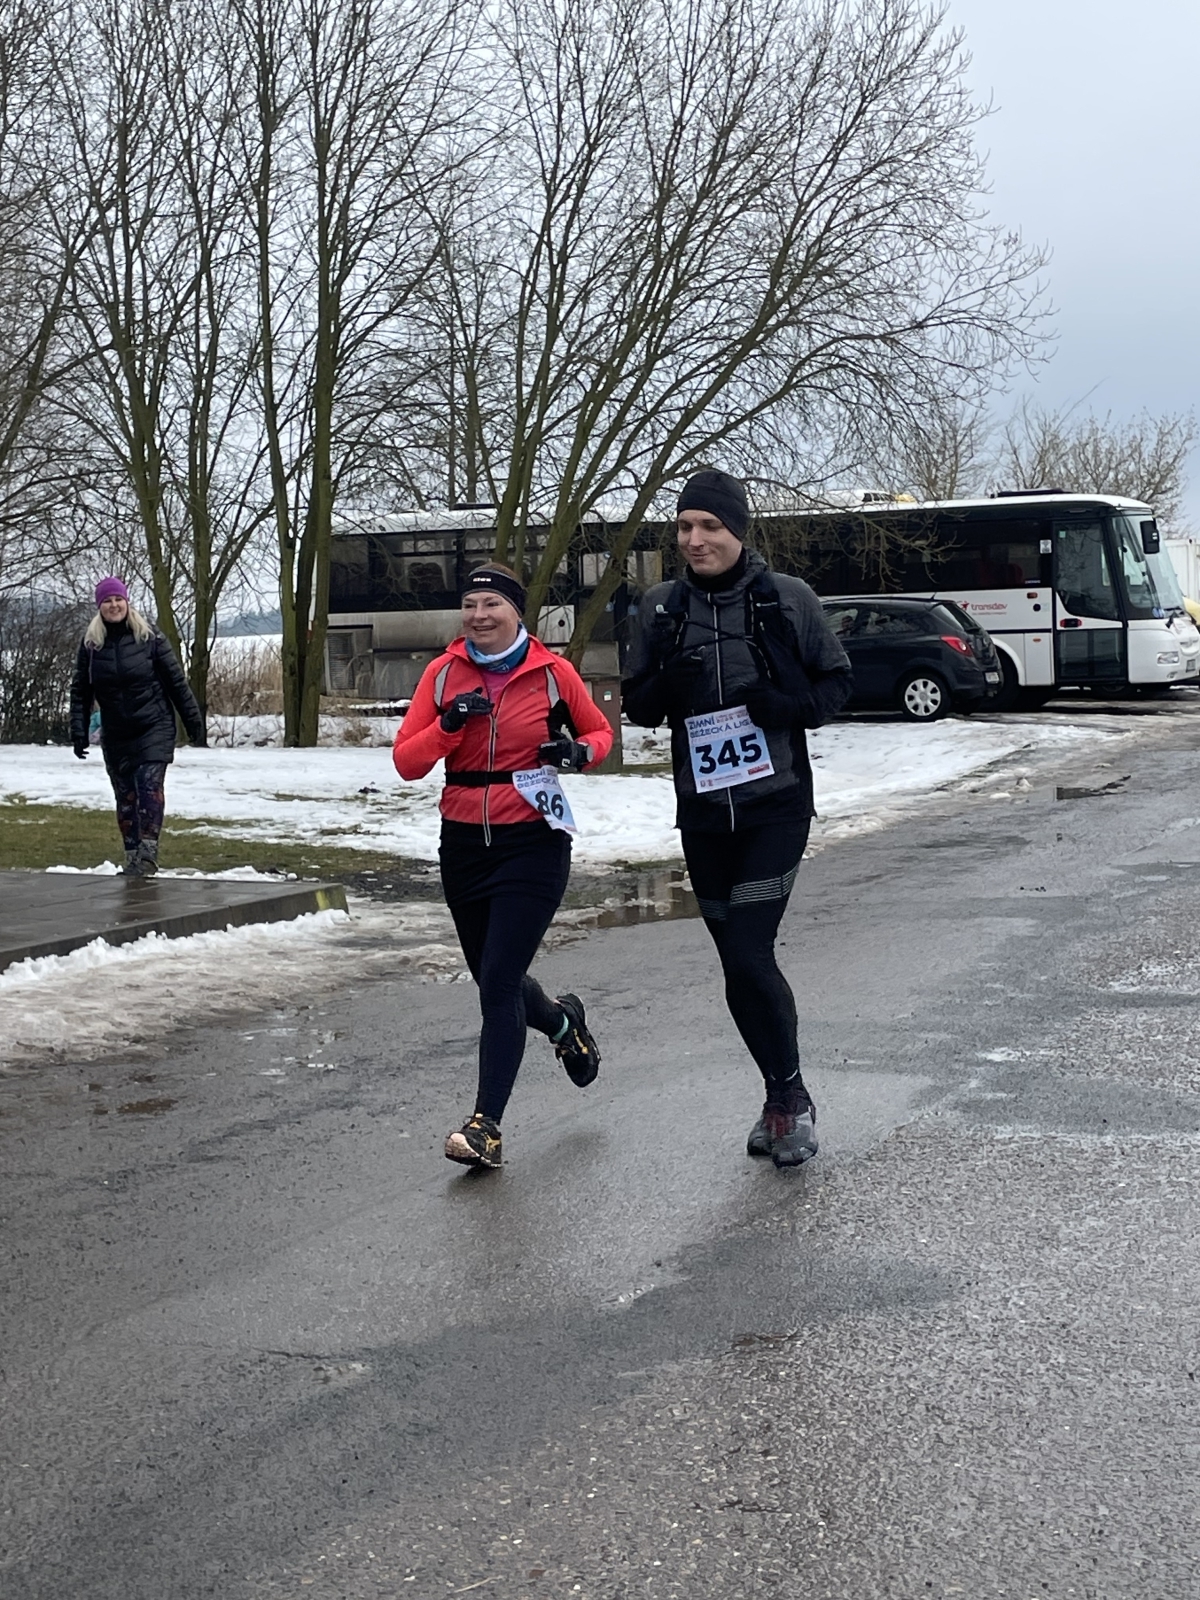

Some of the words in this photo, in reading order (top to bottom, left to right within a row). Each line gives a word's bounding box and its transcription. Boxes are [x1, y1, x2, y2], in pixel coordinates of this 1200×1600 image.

[971, 602, 1007, 610] transdev
[695, 733, 762, 774] 345
[535, 790, 564, 820] 86
